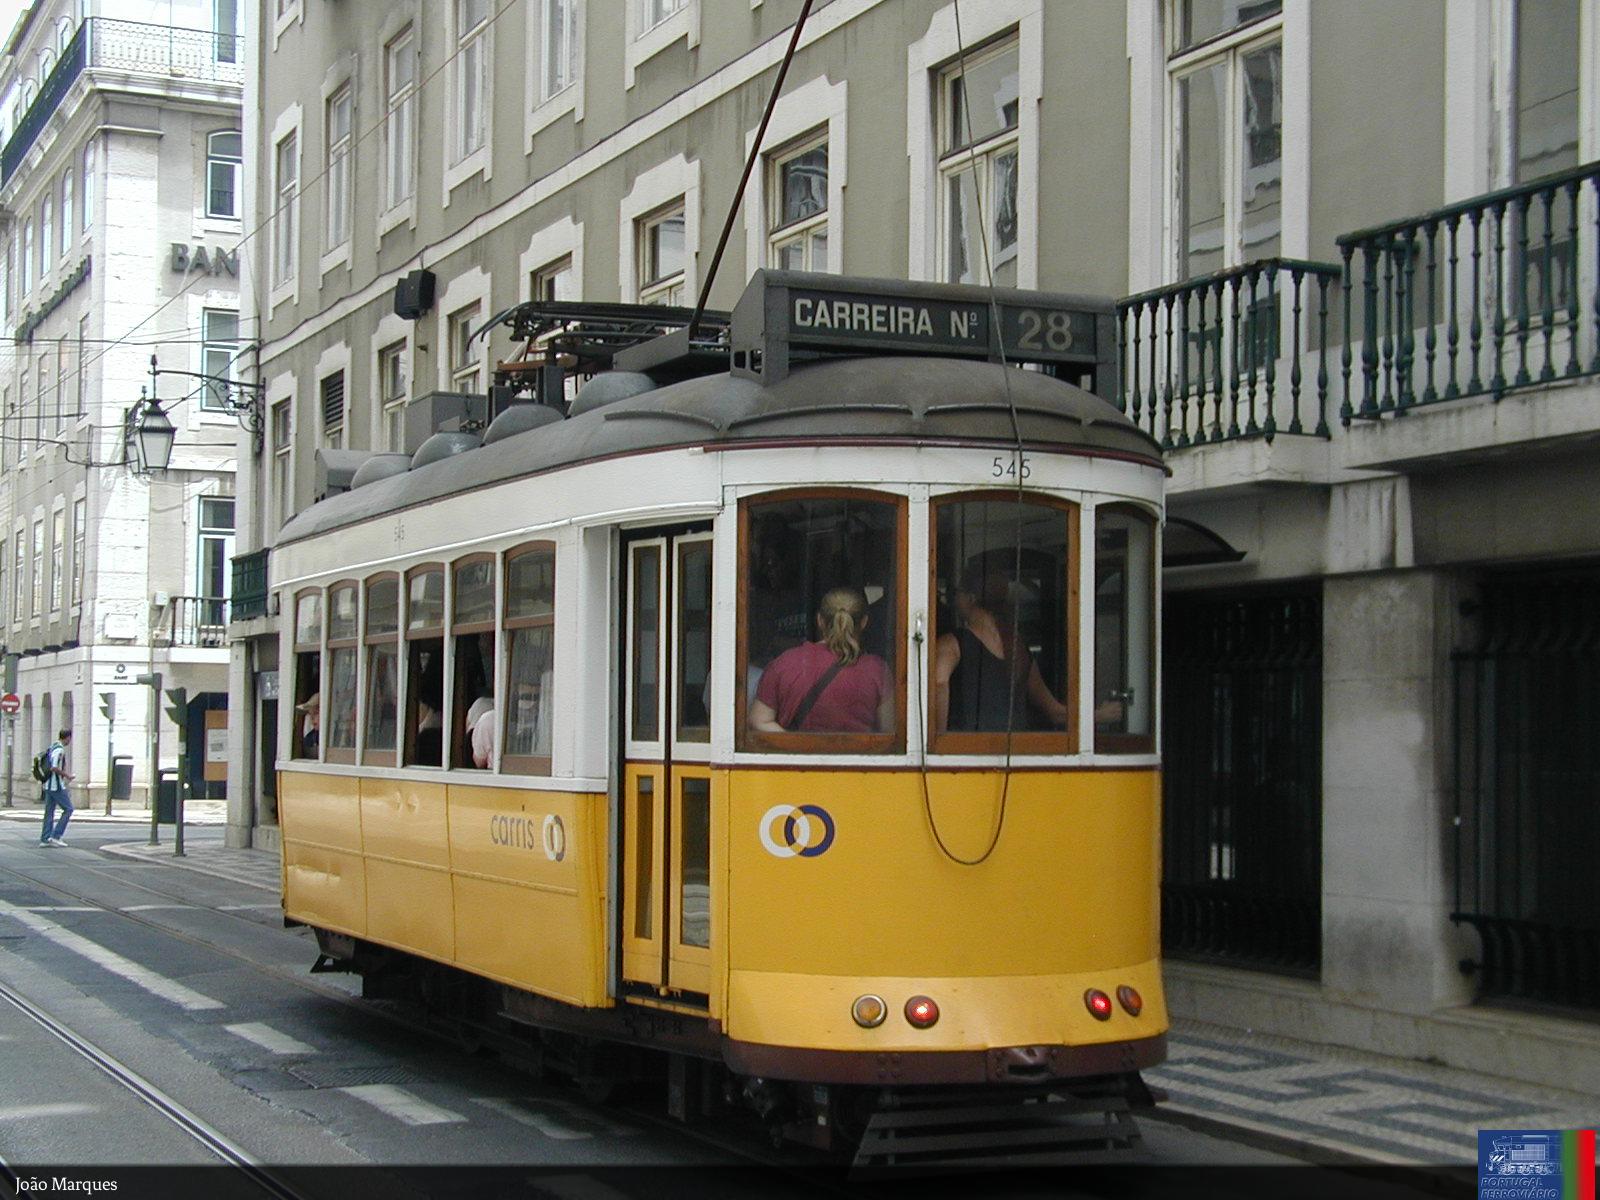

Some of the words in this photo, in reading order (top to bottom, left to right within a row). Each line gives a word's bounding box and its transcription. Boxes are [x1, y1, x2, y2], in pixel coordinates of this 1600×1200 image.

[794, 298, 934, 337] CARREIRA
[1017, 310, 1073, 351] 28
[490, 814, 534, 850] carris
